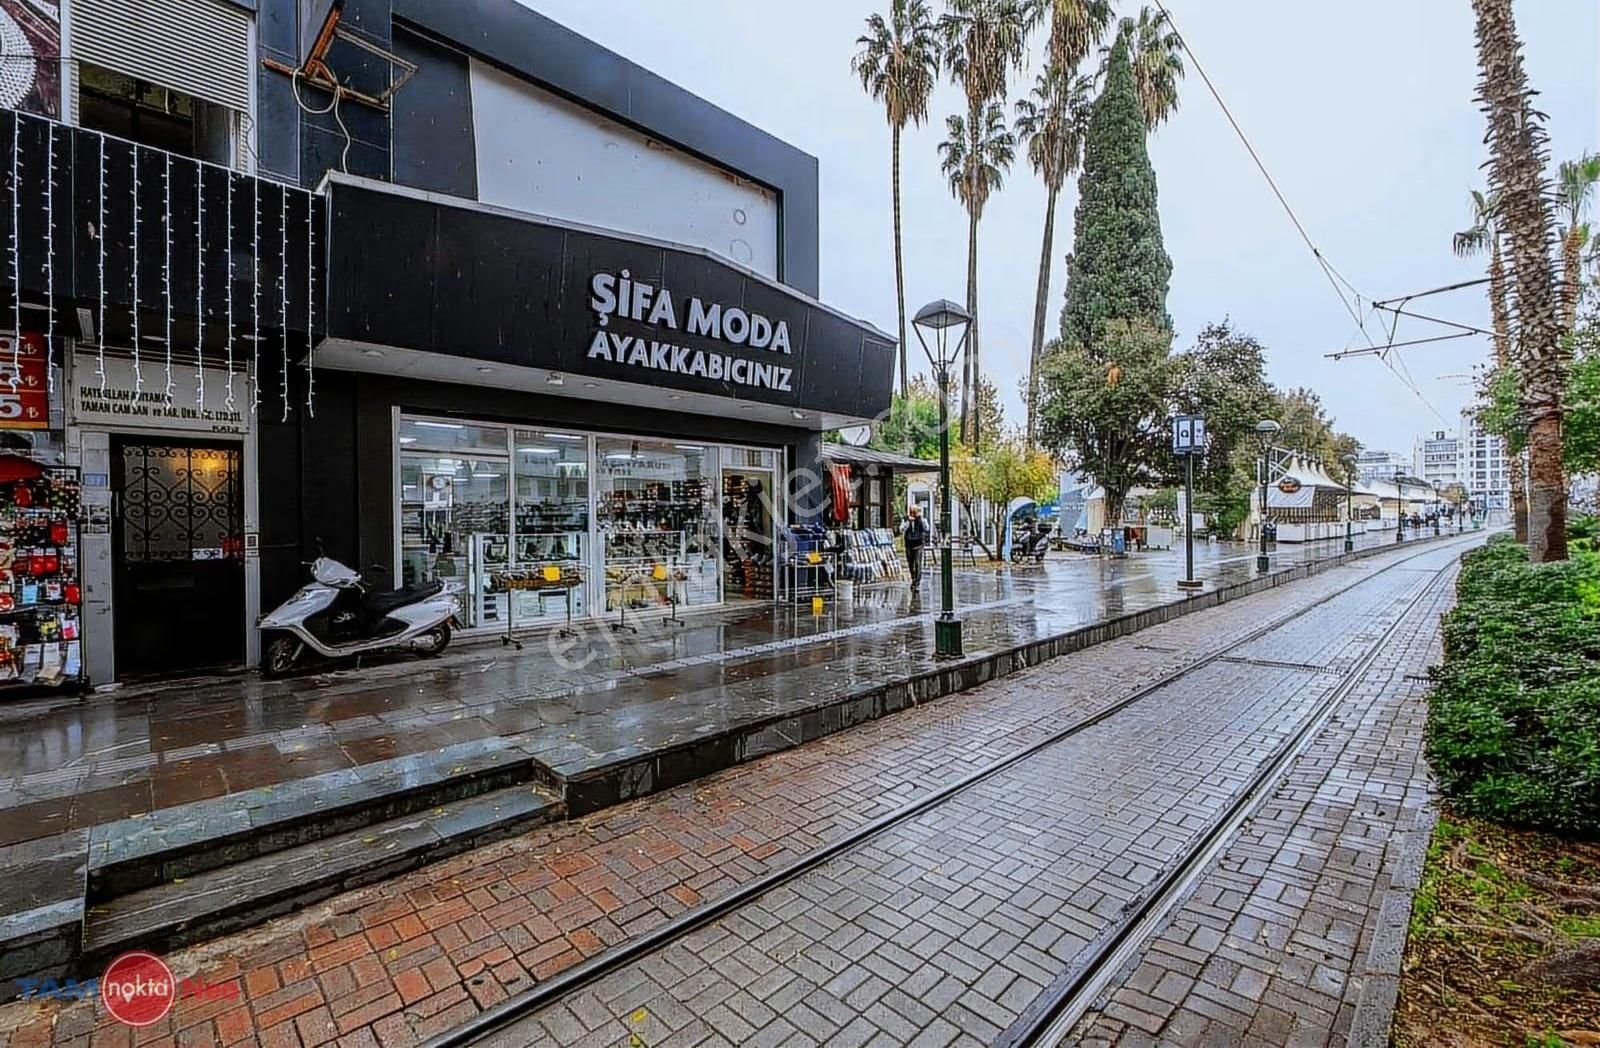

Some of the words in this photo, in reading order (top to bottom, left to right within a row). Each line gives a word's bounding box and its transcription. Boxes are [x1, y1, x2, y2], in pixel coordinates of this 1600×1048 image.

[591, 268, 677, 327] ŞİFA
[687, 297, 792, 355] MODA
[586, 331, 793, 392] AYAKKABICINIZ
[112, 403, 131, 414] CAM
